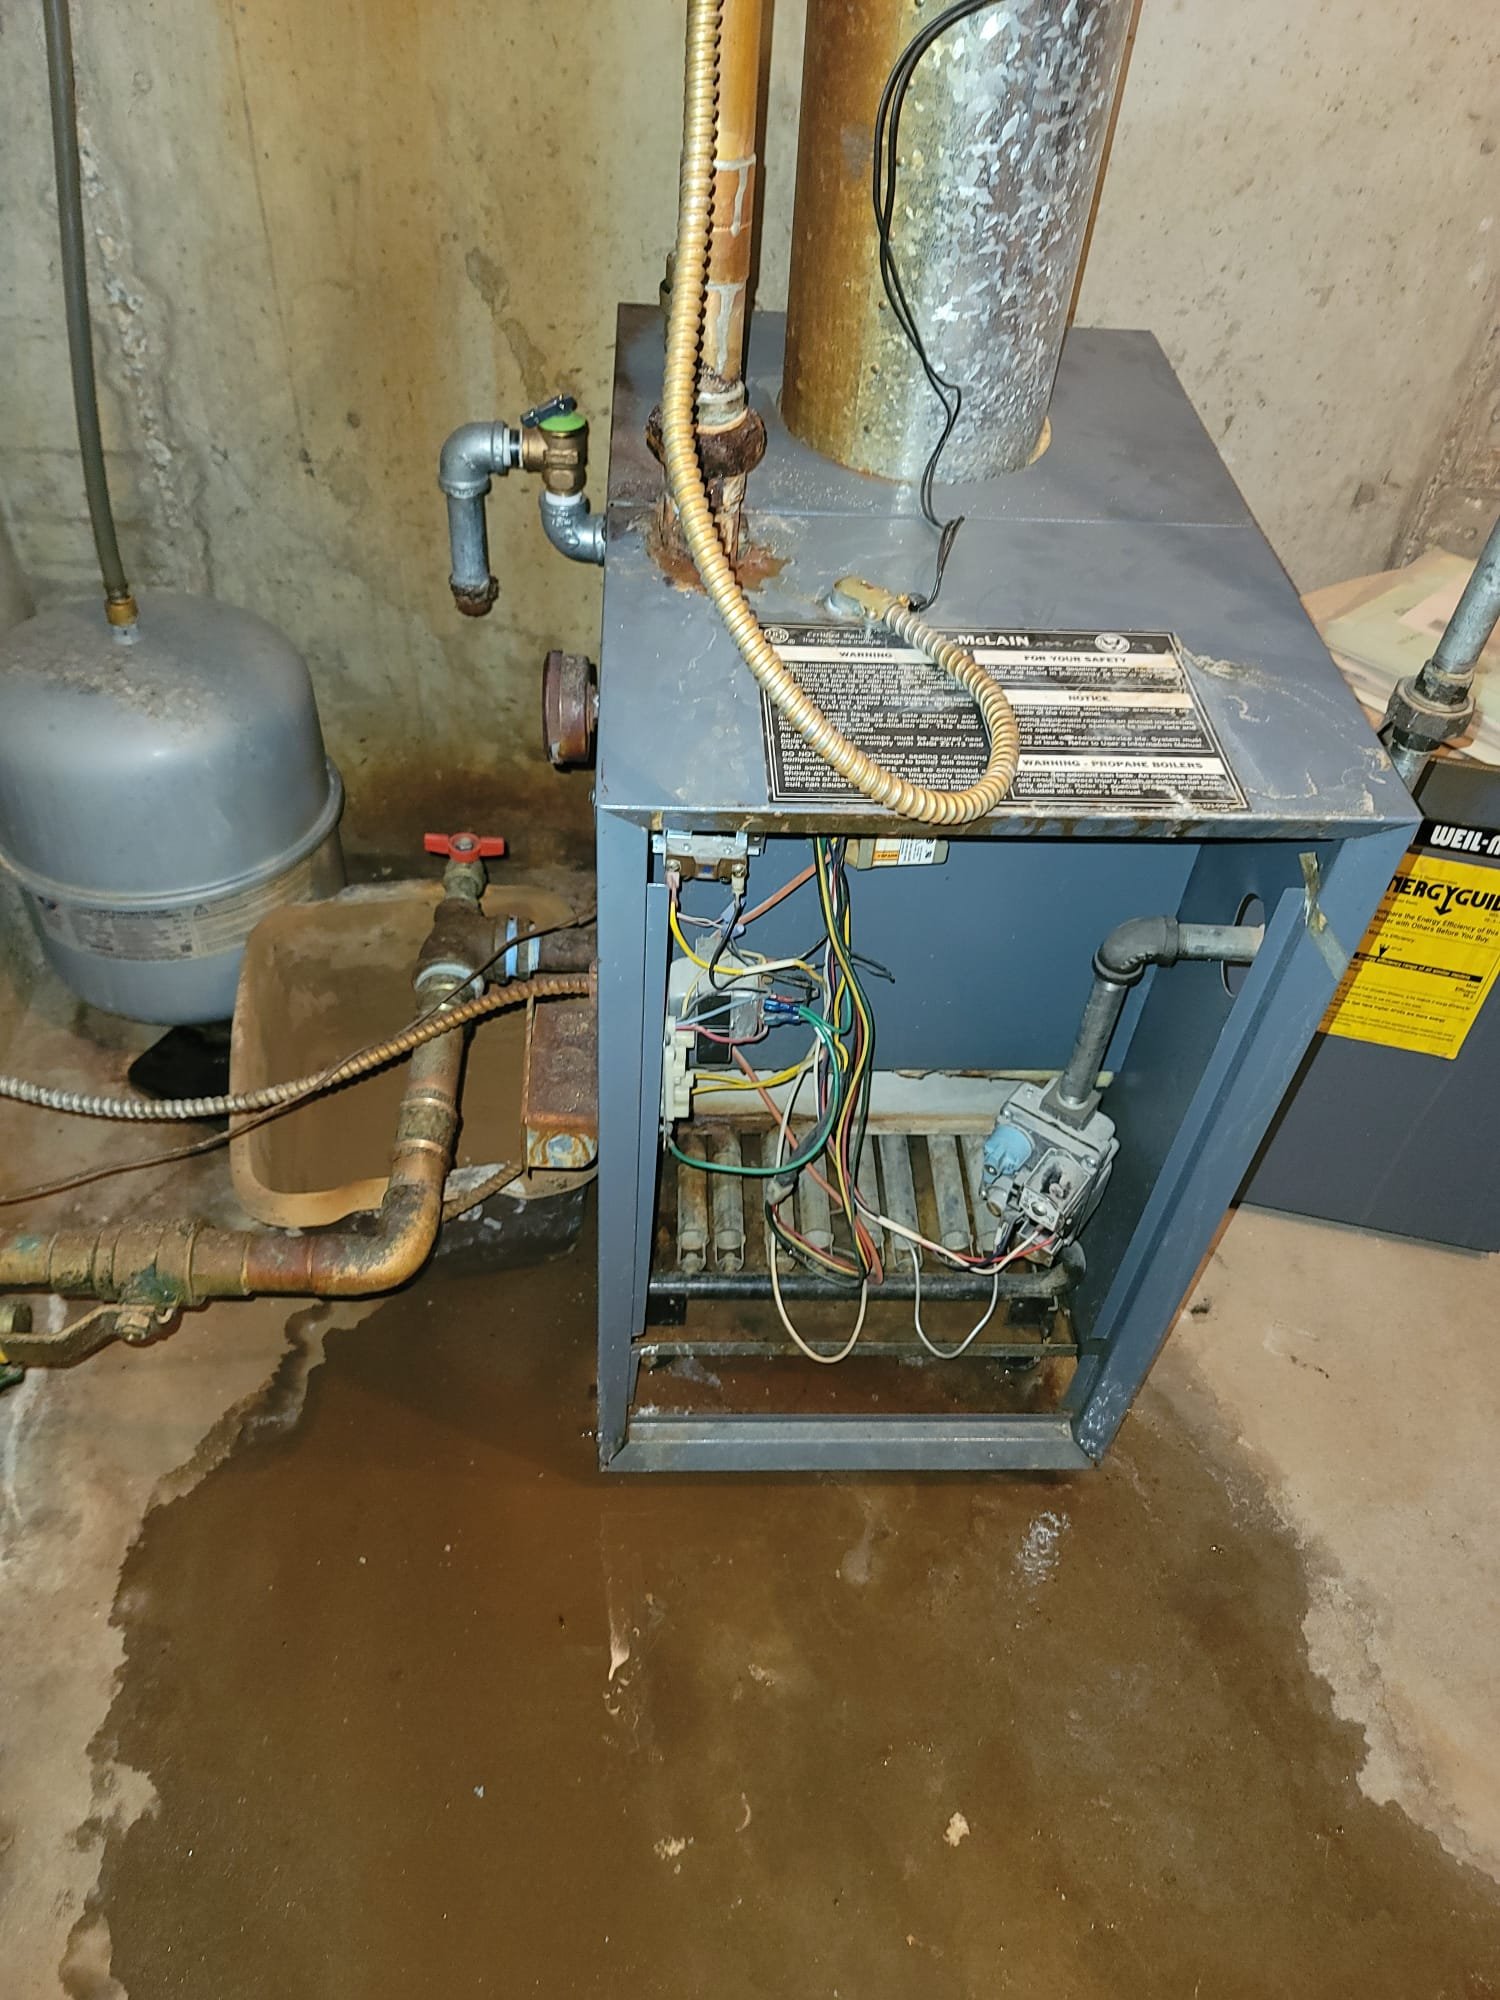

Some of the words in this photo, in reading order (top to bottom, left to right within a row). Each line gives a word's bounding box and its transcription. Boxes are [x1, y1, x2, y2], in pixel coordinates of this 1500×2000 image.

[839, 650, 893, 658] WARNING
[1022, 759, 1081, 767] WARNING
[1091, 760, 1150, 768] PROPANE
[1152, 761, 1204, 769] BOILERS
[1417, 915, 1441, 927] Energy
[1442, 920, 1475, 933] Efficiency
